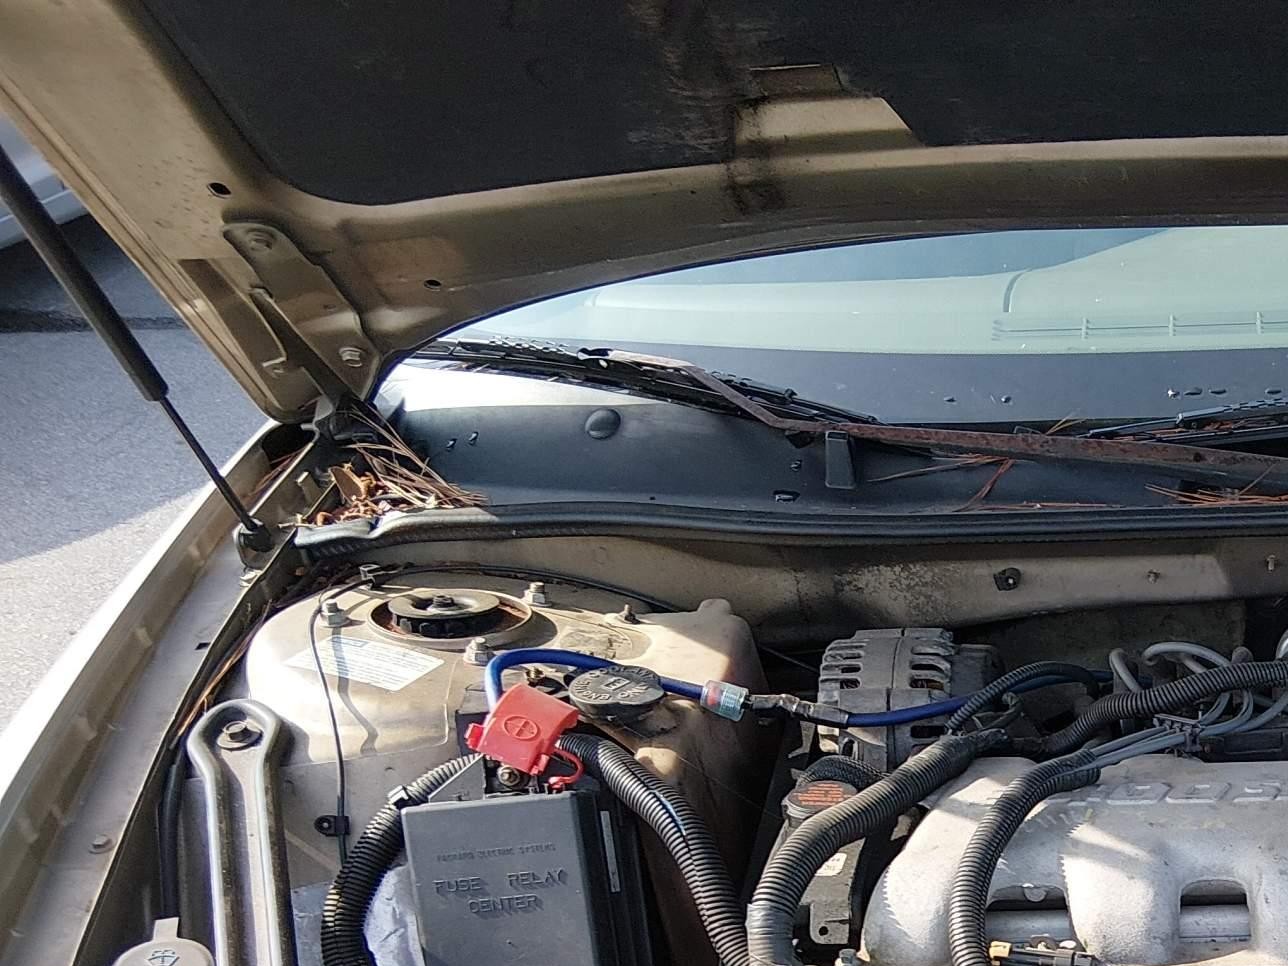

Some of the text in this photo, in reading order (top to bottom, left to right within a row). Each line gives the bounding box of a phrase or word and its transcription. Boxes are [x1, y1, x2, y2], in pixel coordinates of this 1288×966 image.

[433, 867, 568, 893] FUSE RELAY
[467, 894, 539, 914] CENTER
